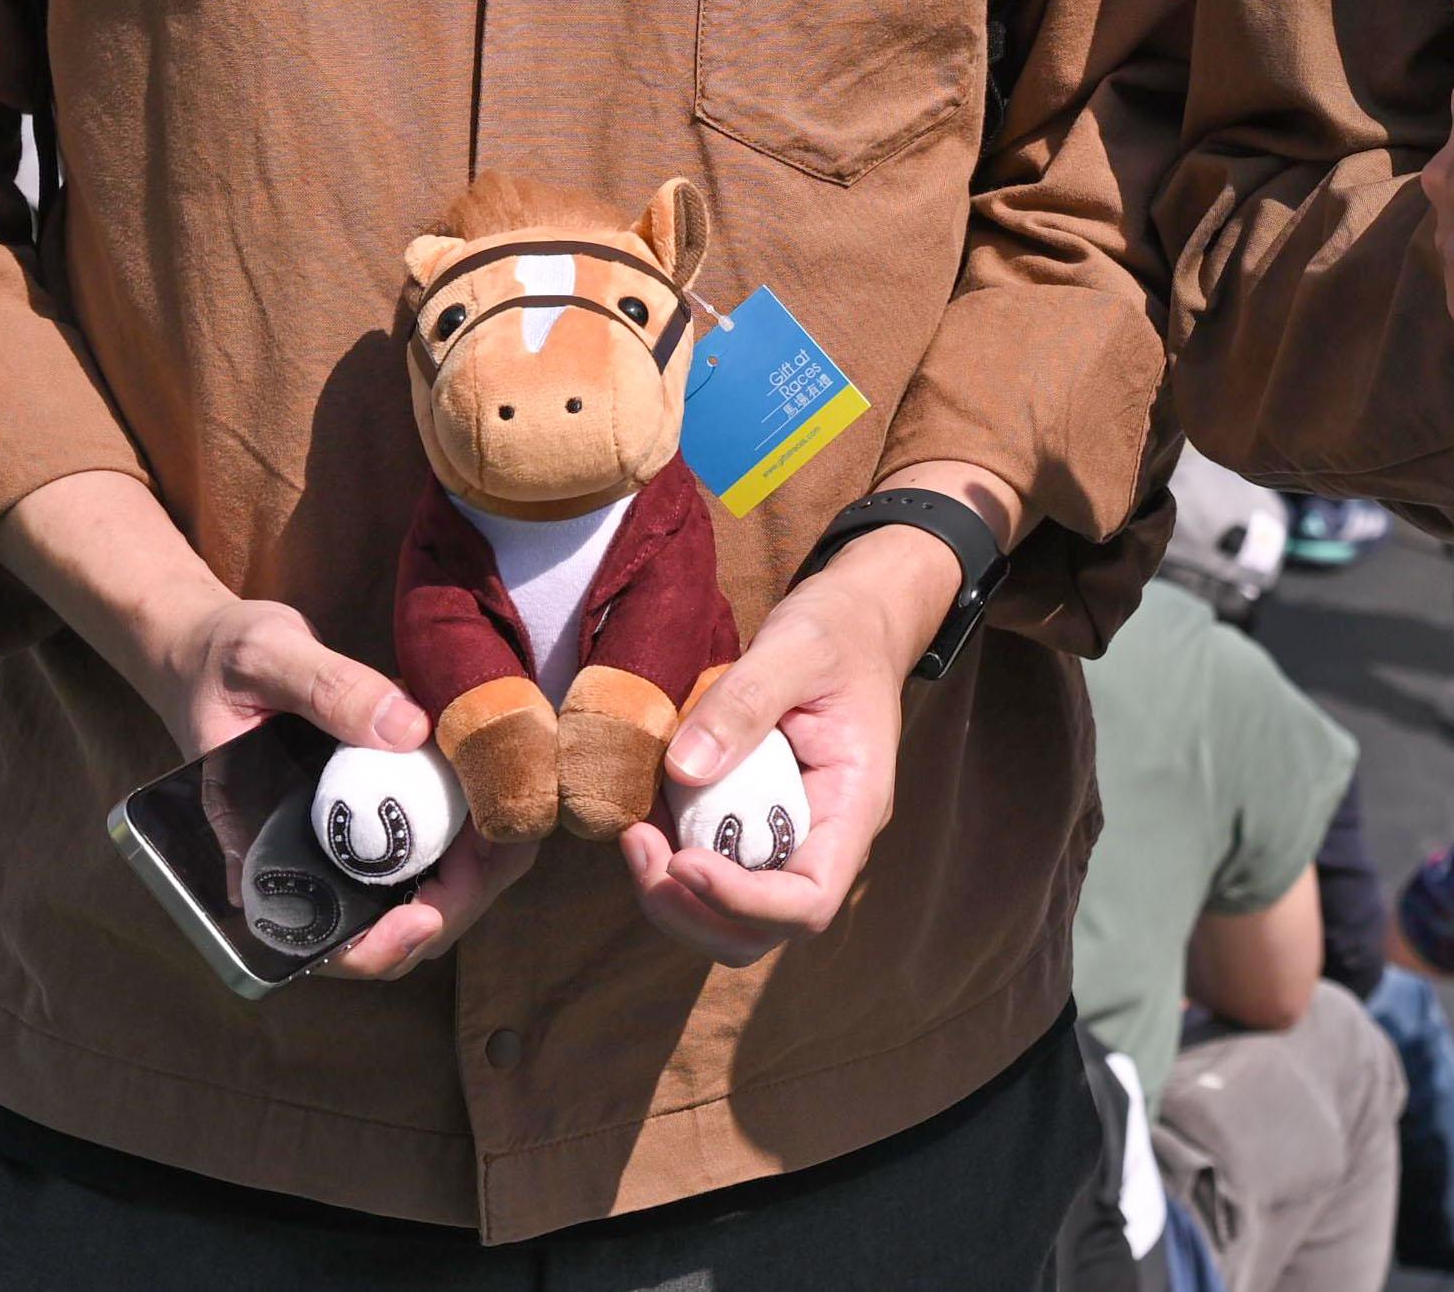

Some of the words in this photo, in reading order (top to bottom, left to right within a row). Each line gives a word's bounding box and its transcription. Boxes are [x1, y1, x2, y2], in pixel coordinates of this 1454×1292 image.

[769, 359, 796, 387] Gift
[793, 349, 810, 368] at
[778, 361, 822, 399] Races
[782, 372, 835, 418] 馬場有禮
